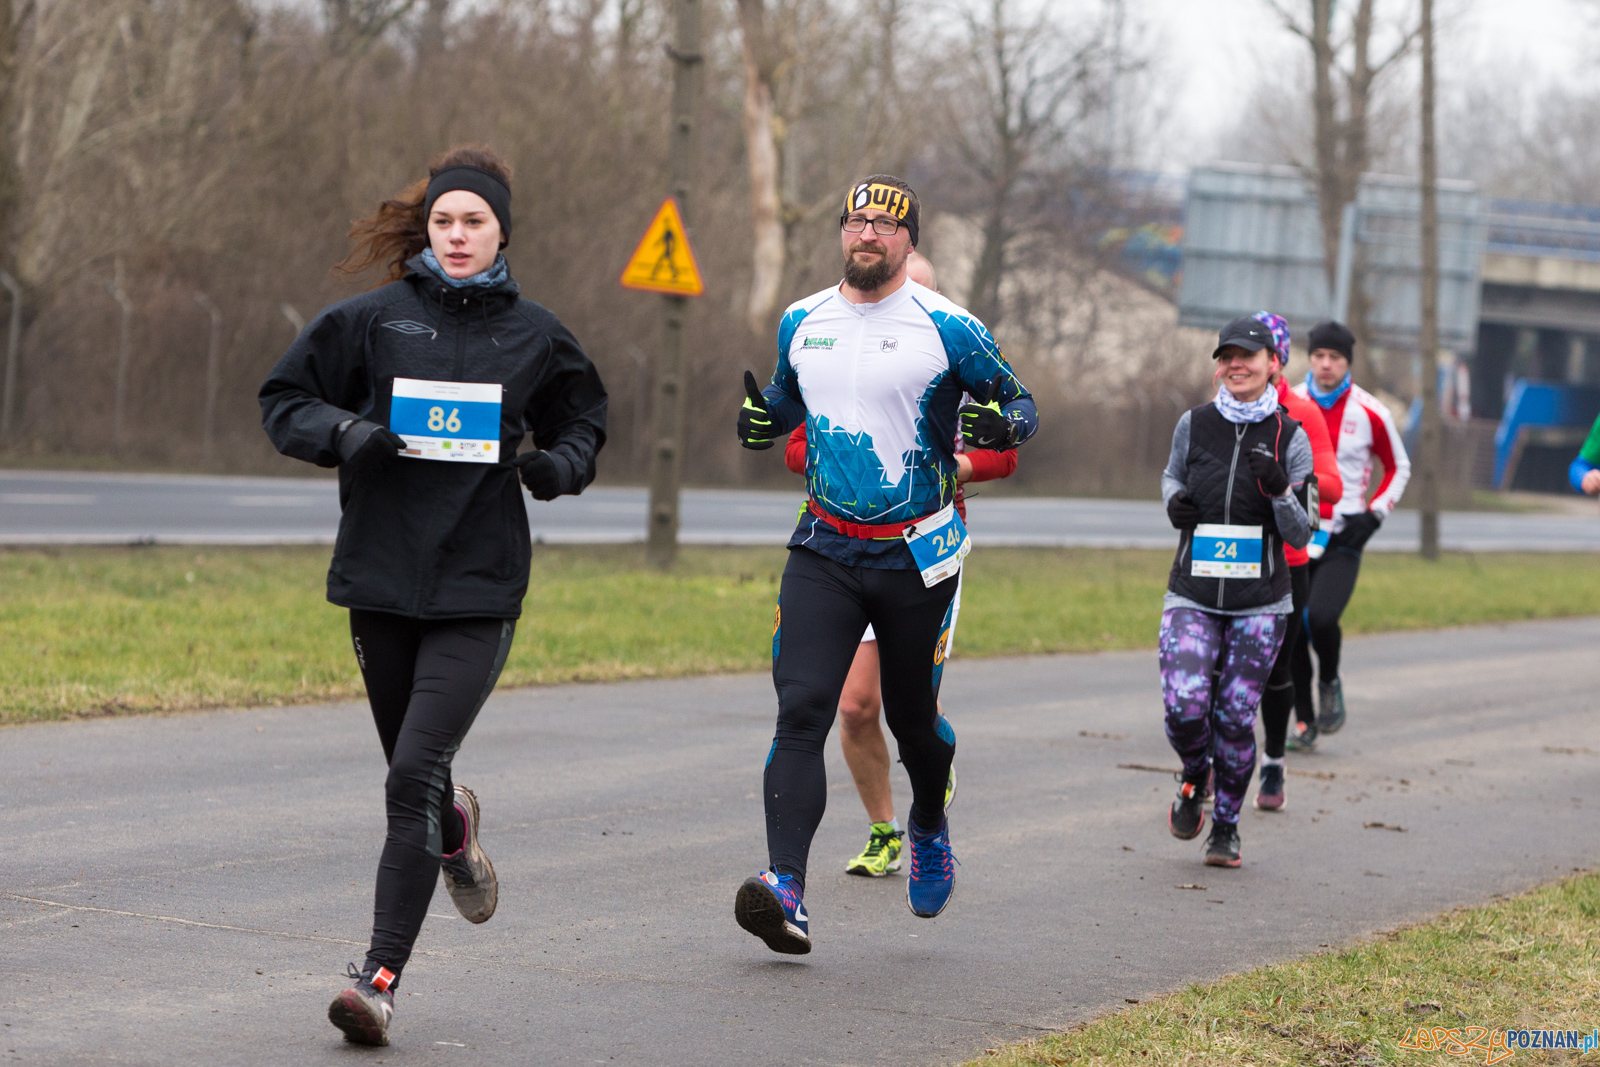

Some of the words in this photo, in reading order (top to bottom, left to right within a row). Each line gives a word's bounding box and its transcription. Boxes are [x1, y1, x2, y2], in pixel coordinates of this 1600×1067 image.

[427, 406, 462, 433] 86
[932, 523, 960, 557] 246
[1214, 541, 1238, 559] 24
